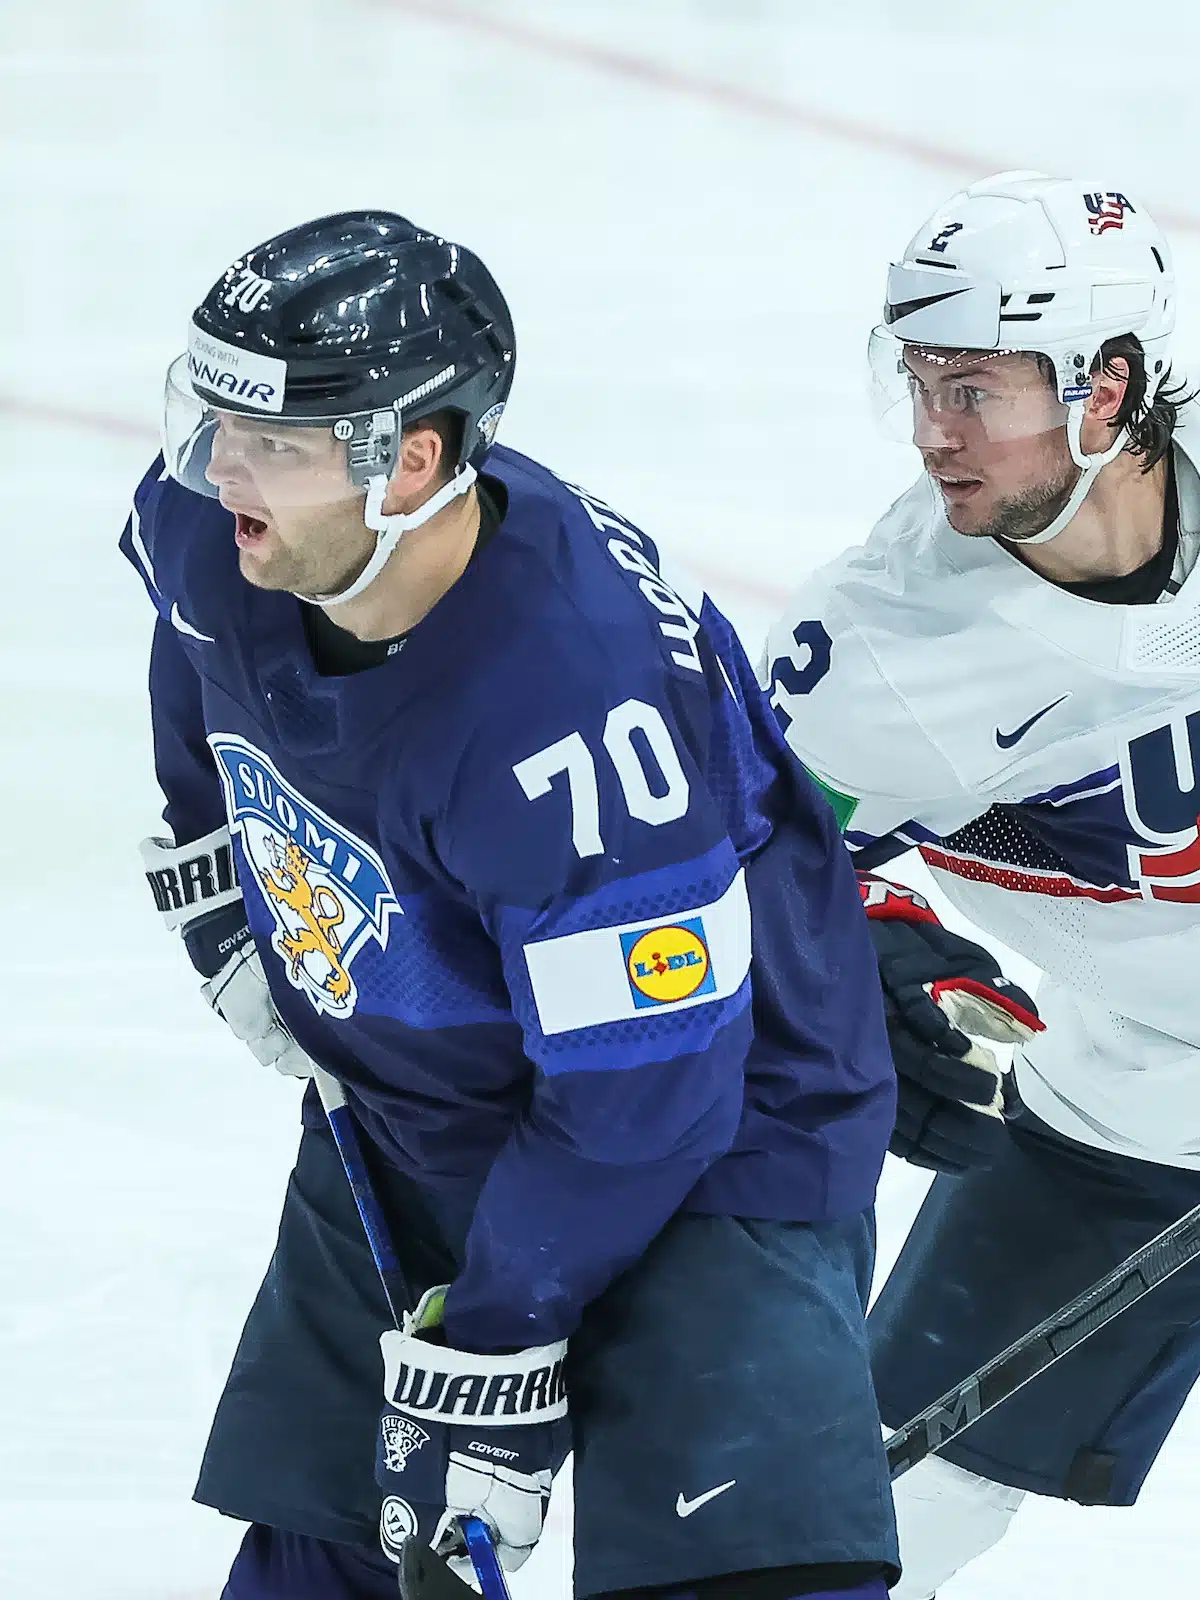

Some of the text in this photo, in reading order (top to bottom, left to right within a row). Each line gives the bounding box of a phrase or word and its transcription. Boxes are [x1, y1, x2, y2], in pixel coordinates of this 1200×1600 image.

[1083, 191, 1137, 236] USA
[927, 222, 963, 252] 2
[770, 619, 832, 736] 2
[512, 697, 690, 859] 70
[237, 761, 365, 880] SUOMI
[384, 1418, 421, 1440] SUOMI
[467, 1440, 520, 1461] COVERT
